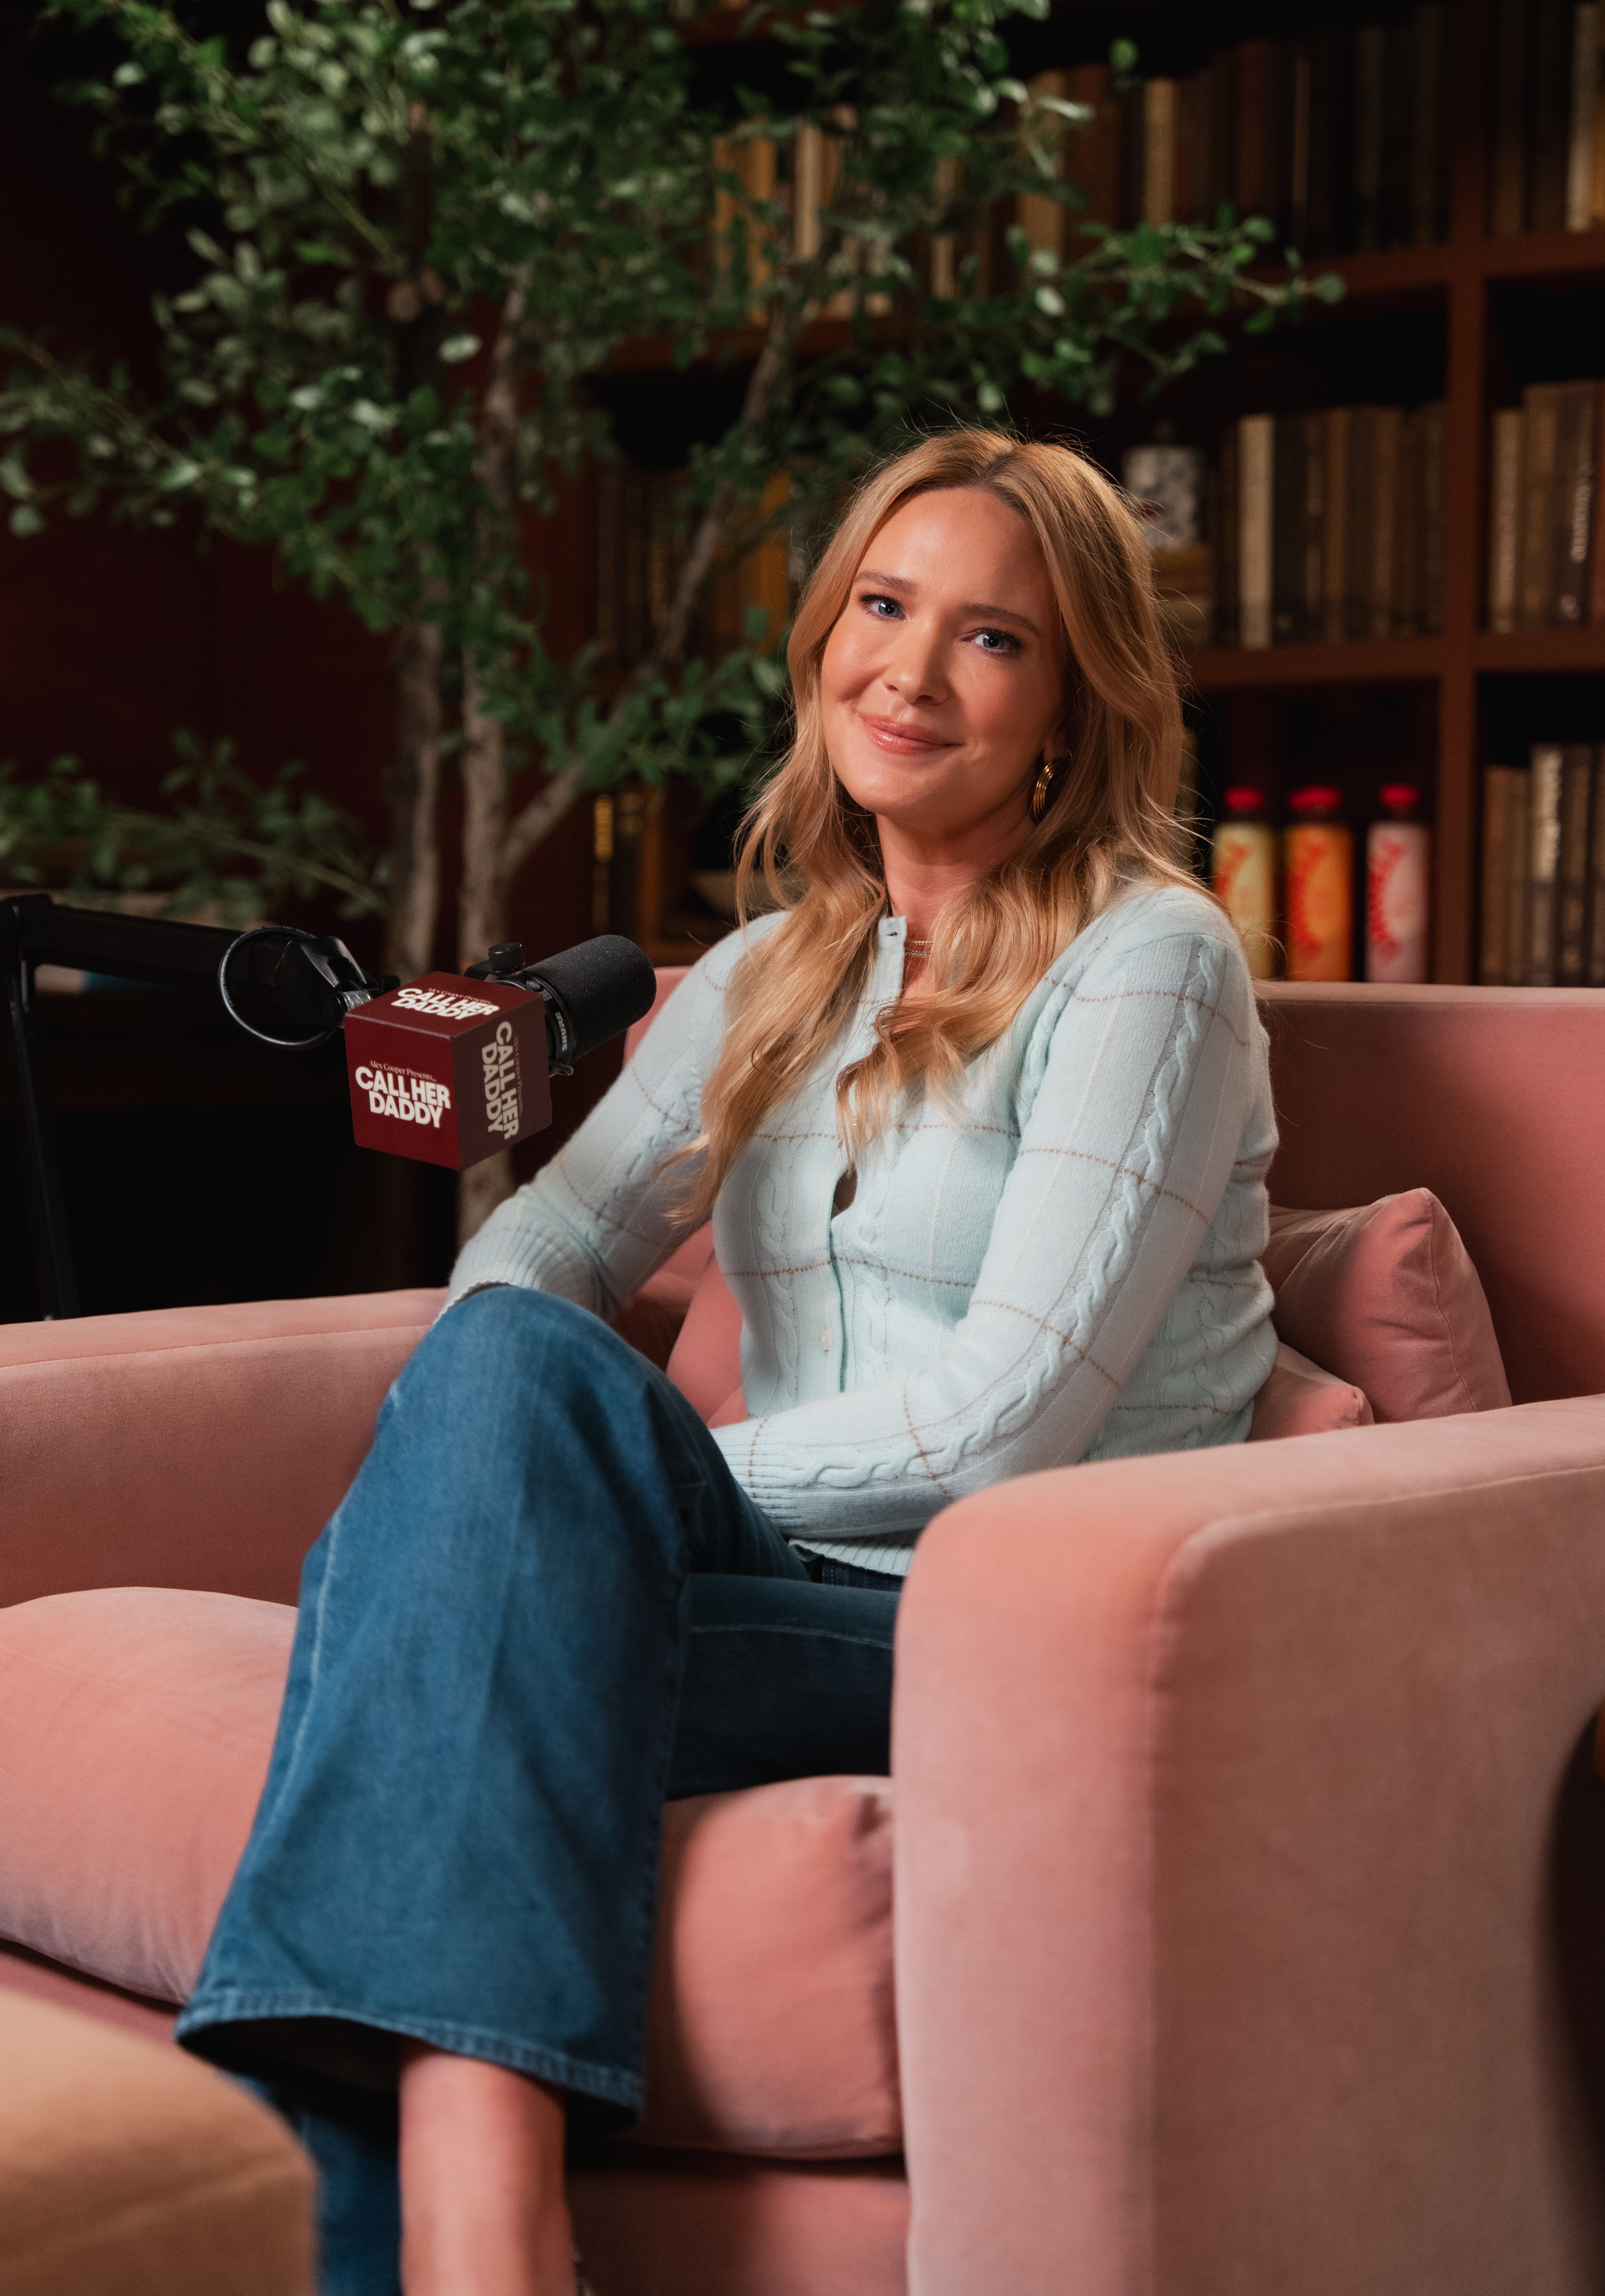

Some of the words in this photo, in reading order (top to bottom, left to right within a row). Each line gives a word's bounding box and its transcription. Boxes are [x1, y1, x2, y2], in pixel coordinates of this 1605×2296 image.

[391, 997, 478, 1020] DADDY
[398, 988, 456, 1007] CALL
[450, 999, 500, 1015] HER
[554, 1011, 567, 1051] SHURE
[369, 1060, 383, 1069] Alex
[383, 1063, 406, 1074] Cooper
[496, 1021, 515, 1091] CALL
[355, 1066, 410, 1099] CALL
[410, 1078, 451, 1109] HER
[482, 1041, 504, 1132] DADDY
[368, 1090, 443, 1128] DADDY
[501, 1087, 519, 1140] HER
